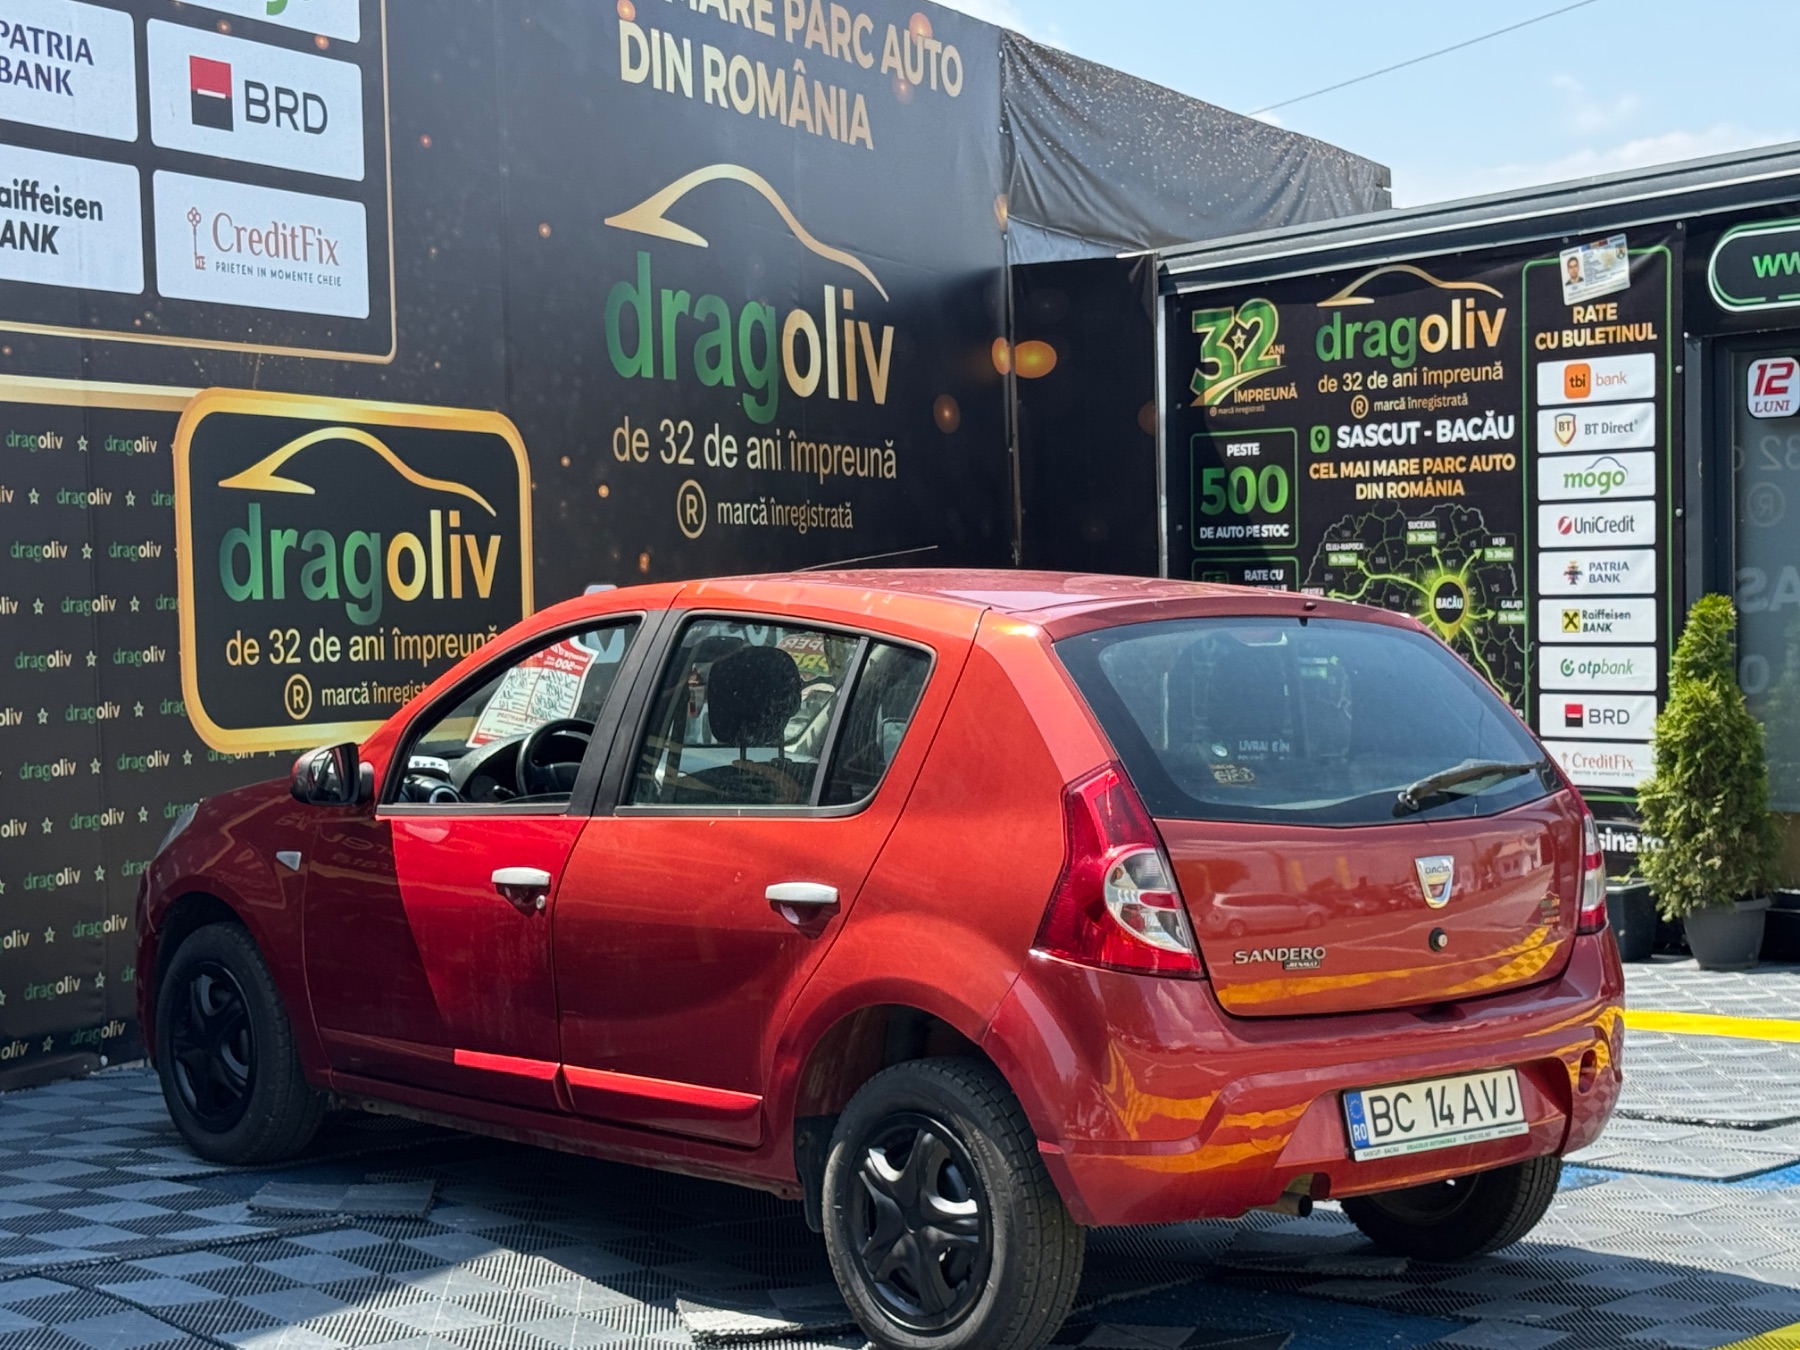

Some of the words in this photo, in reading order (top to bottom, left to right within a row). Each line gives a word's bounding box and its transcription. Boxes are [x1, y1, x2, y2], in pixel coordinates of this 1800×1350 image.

[784, 0, 874, 69] PARC
[881, 24, 963, 98] AUTO
[619, 19, 693, 98] DIN
[703, 44, 873, 149] ROMÂNIA
[244, 80, 328, 135] BRD
[212, 212, 340, 267] CreditFix
[215, 261, 253, 276] PRIETEN
[257, 266, 267, 278] IN
[270, 269, 314, 285] MOMENTE
[317, 276, 342, 287] CHEIE
[1572, 302, 1618, 324] RATE
[604, 250, 894, 425] dragoliv
[1316, 298, 1506, 369] dragoliv
[1535, 332, 1558, 350] CU
[1562, 322, 1657, 347] BULETINUL
[1190, 298, 1280, 396] 32
[1318, 373, 1338, 393] de
[1342, 372, 1362, 391] 32
[1367, 370, 1388, 389] de
[1392, 366, 1417, 387] ani
[1422, 361, 1504, 387] împreună
[1569, 373, 1586, 388] tbi
[1596, 371, 1627, 387] bank
[1753, 362, 1795, 397] 12
[1233, 382, 1298, 403] ÎMPREUNĂ
[1374, 396, 1406, 412] marcă
[1407, 392, 1468, 413] înregistrată
[1754, 400, 1791, 413] LUNI
[1337, 421, 1421, 449] SASCUT
[1437, 410, 1515, 443] BACĂU
[1558, 421, 1571, 432] BT
[1584, 423, 1599, 436] BT
[5, 431, 63, 452] dragoliv
[104, 435, 157, 456] dragoliv
[613, 416, 650, 463] de
[660, 418, 695, 466] 32
[704, 423, 738, 469] de
[746, 428, 782, 471] ani
[788, 430, 897, 484] împreună
[1226, 443, 1260, 457] PESTE
[1309, 463, 1338, 480] CEL
[1340, 460, 1370, 478] MAI
[1373, 457, 1421, 477] MARE
[1423, 455, 1468, 474] PARC
[1469, 453, 1516, 473] AUTO
[1201, 464, 1289, 516] 500
[1356, 482, 1384, 500] DIN
[1386, 478, 1465, 498] ROMÂNIA
[1563, 471, 1626, 495] mogo
[56, 487, 112, 509] dragoliv
[717, 496, 768, 526] marcă
[770, 497, 853, 534] înregistrată
[1574, 515, 1635, 534] UniCredit
[1200, 526, 1215, 539] DE
[1216, 525, 1244, 539] AUTO
[1246, 525, 1261, 538] PE
[1261, 524, 1289, 537] STOC
[10, 541, 67, 562] dragoliv
[109, 541, 161, 562] dragoliv
[218, 502, 501, 626] dragoliv
[1244, 569, 1269, 581] RATE
[1269, 569, 1284, 580] CU
[1588, 561, 1630, 573] PATRIA
[1588, 572, 1620, 584] BANK
[61, 595, 116, 616] dragoliv
[1436, 595, 1464, 609] BACĂU
[1582, 609, 1631, 620] Raiffeisen
[1582, 622, 1613, 633] BANK
[113, 645, 165, 668] dragoliv
[226, 630, 260, 666] de
[269, 628, 301, 664] 32
[309, 628, 341, 663] de
[349, 628, 385, 661] ani
[15, 650, 72, 672] dragoliv
[1578, 658, 1634, 679] otpbank
[321, 681, 369, 707] marcă
[65, 701, 120, 724] dragoliv
[1589, 708, 1630, 725] BRD
[20, 758, 76, 781] dragoliv
[117, 750, 170, 773] dragoliv
[1572, 752, 1633, 771] CreditFix
[70, 809, 124, 831] dragoliv
[23, 867, 81, 891] dragoliv
[1425, 865, 1450, 875] DACIA
[72, 914, 127, 938] dragoliv
[1234, 946, 1326, 965] SANDERO
[24, 976, 81, 1000] dragoliv
[70, 1021, 125, 1045] dragoliv
[1369, 1092, 1416, 1138] BC
[1425, 1085, 1455, 1129] 14
[1463, 1076, 1516, 1125] AVJ
[1352, 1123, 1368, 1142] RO
